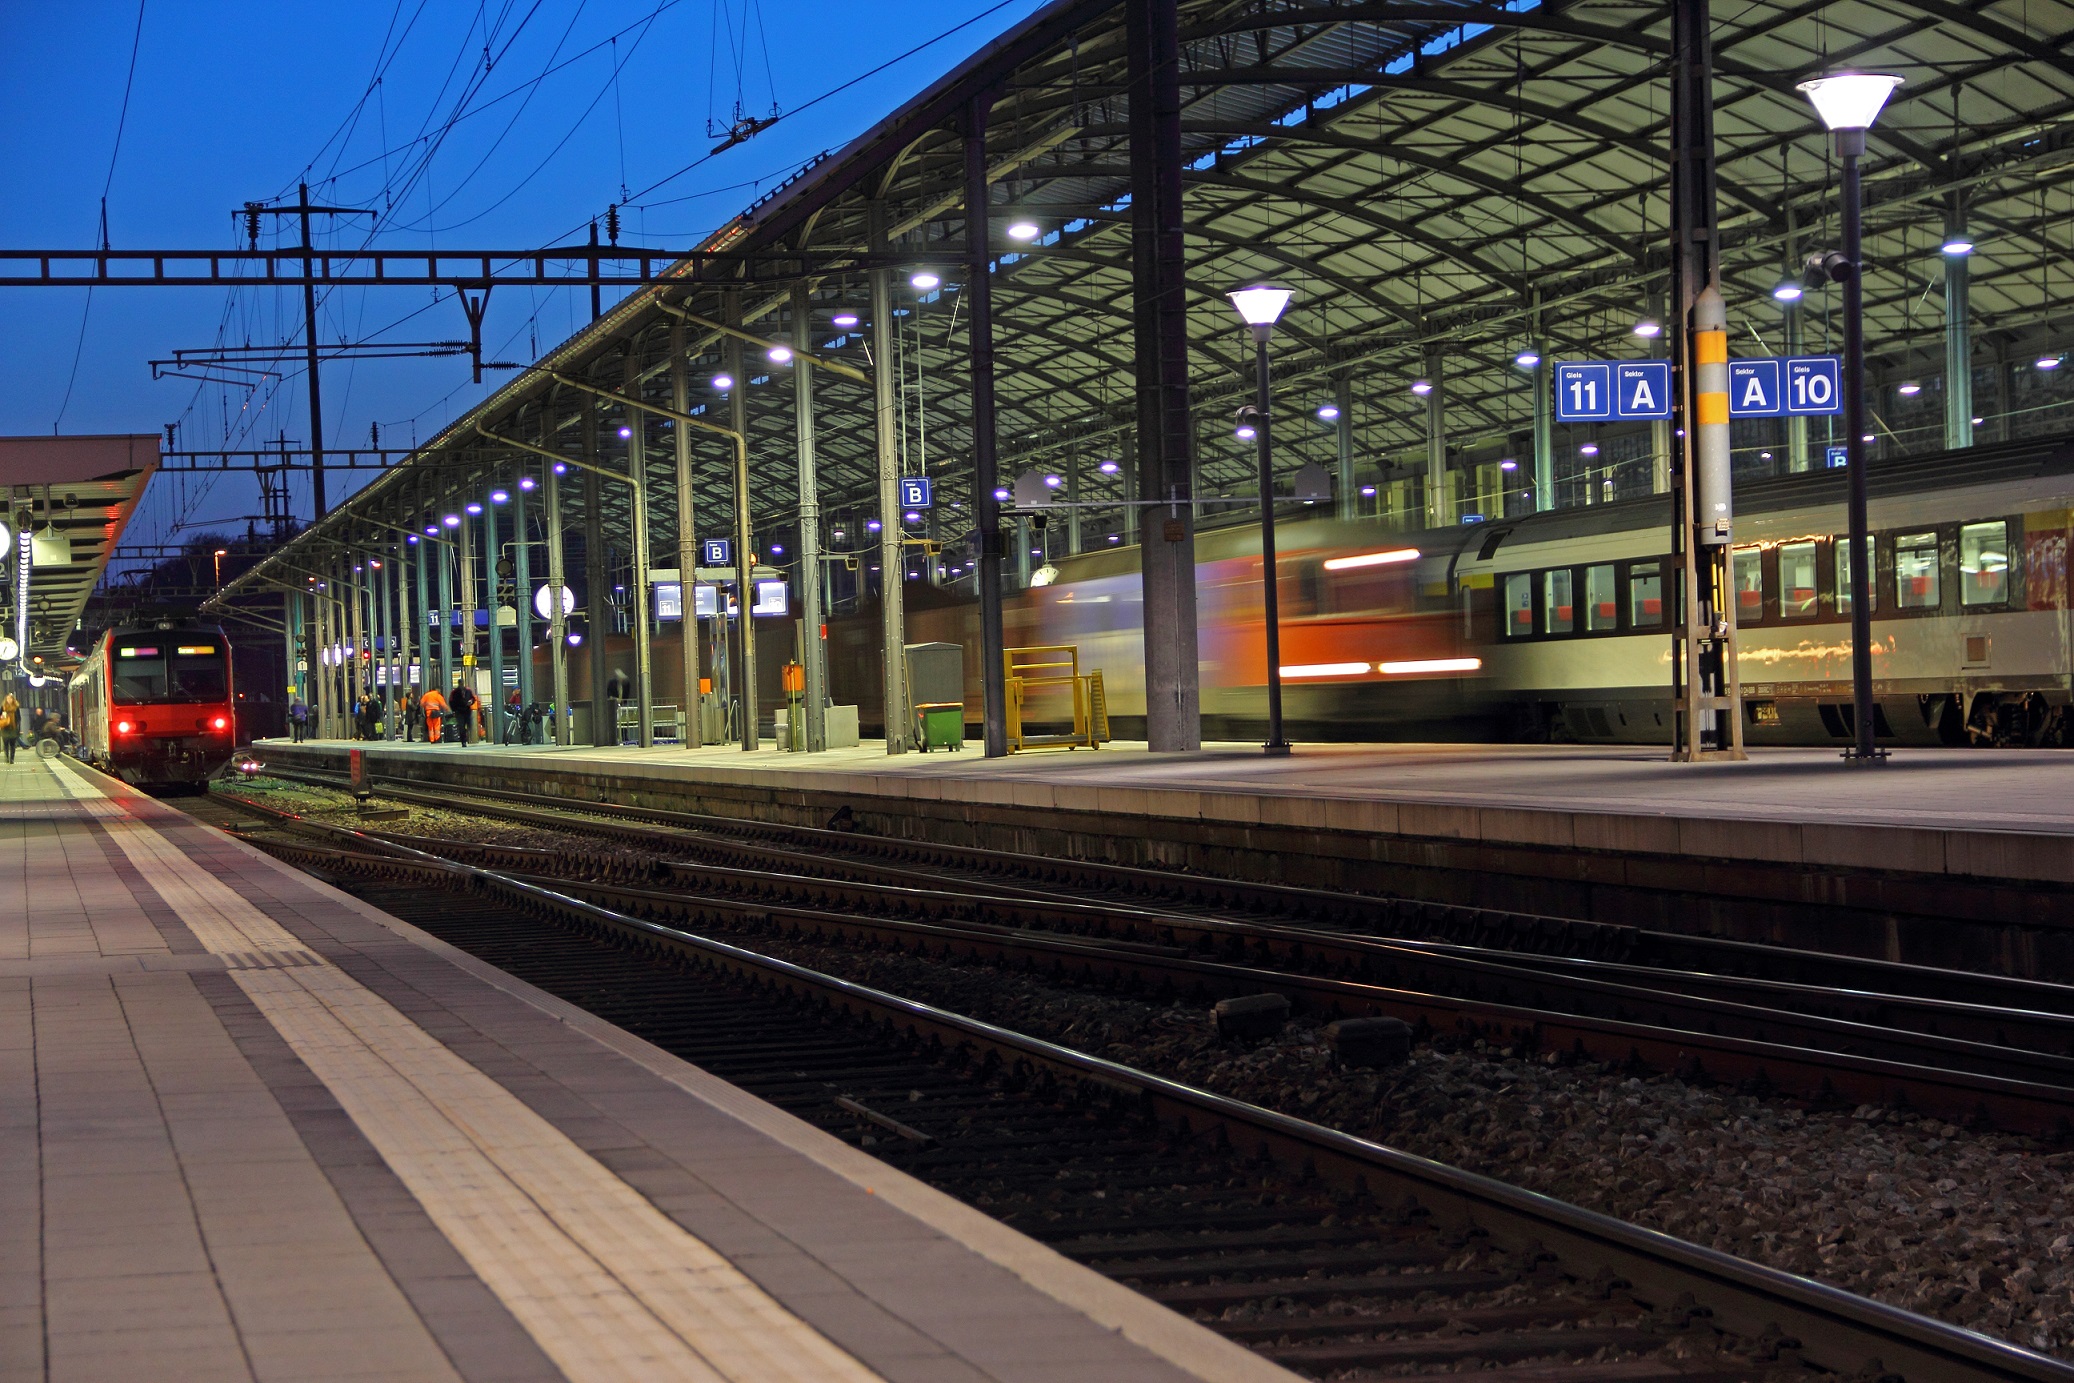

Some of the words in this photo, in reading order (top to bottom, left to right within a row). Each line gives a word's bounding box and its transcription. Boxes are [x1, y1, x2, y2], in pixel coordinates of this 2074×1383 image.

[1570, 381, 1596, 410] 11
[1631, 380, 1655, 409] A
[1743, 377, 1767, 406] A
[1794, 374, 1831, 405] 10
[910, 487, 922, 502] B
[713, 546, 722, 559] B
[430, 615, 438, 623] 11
